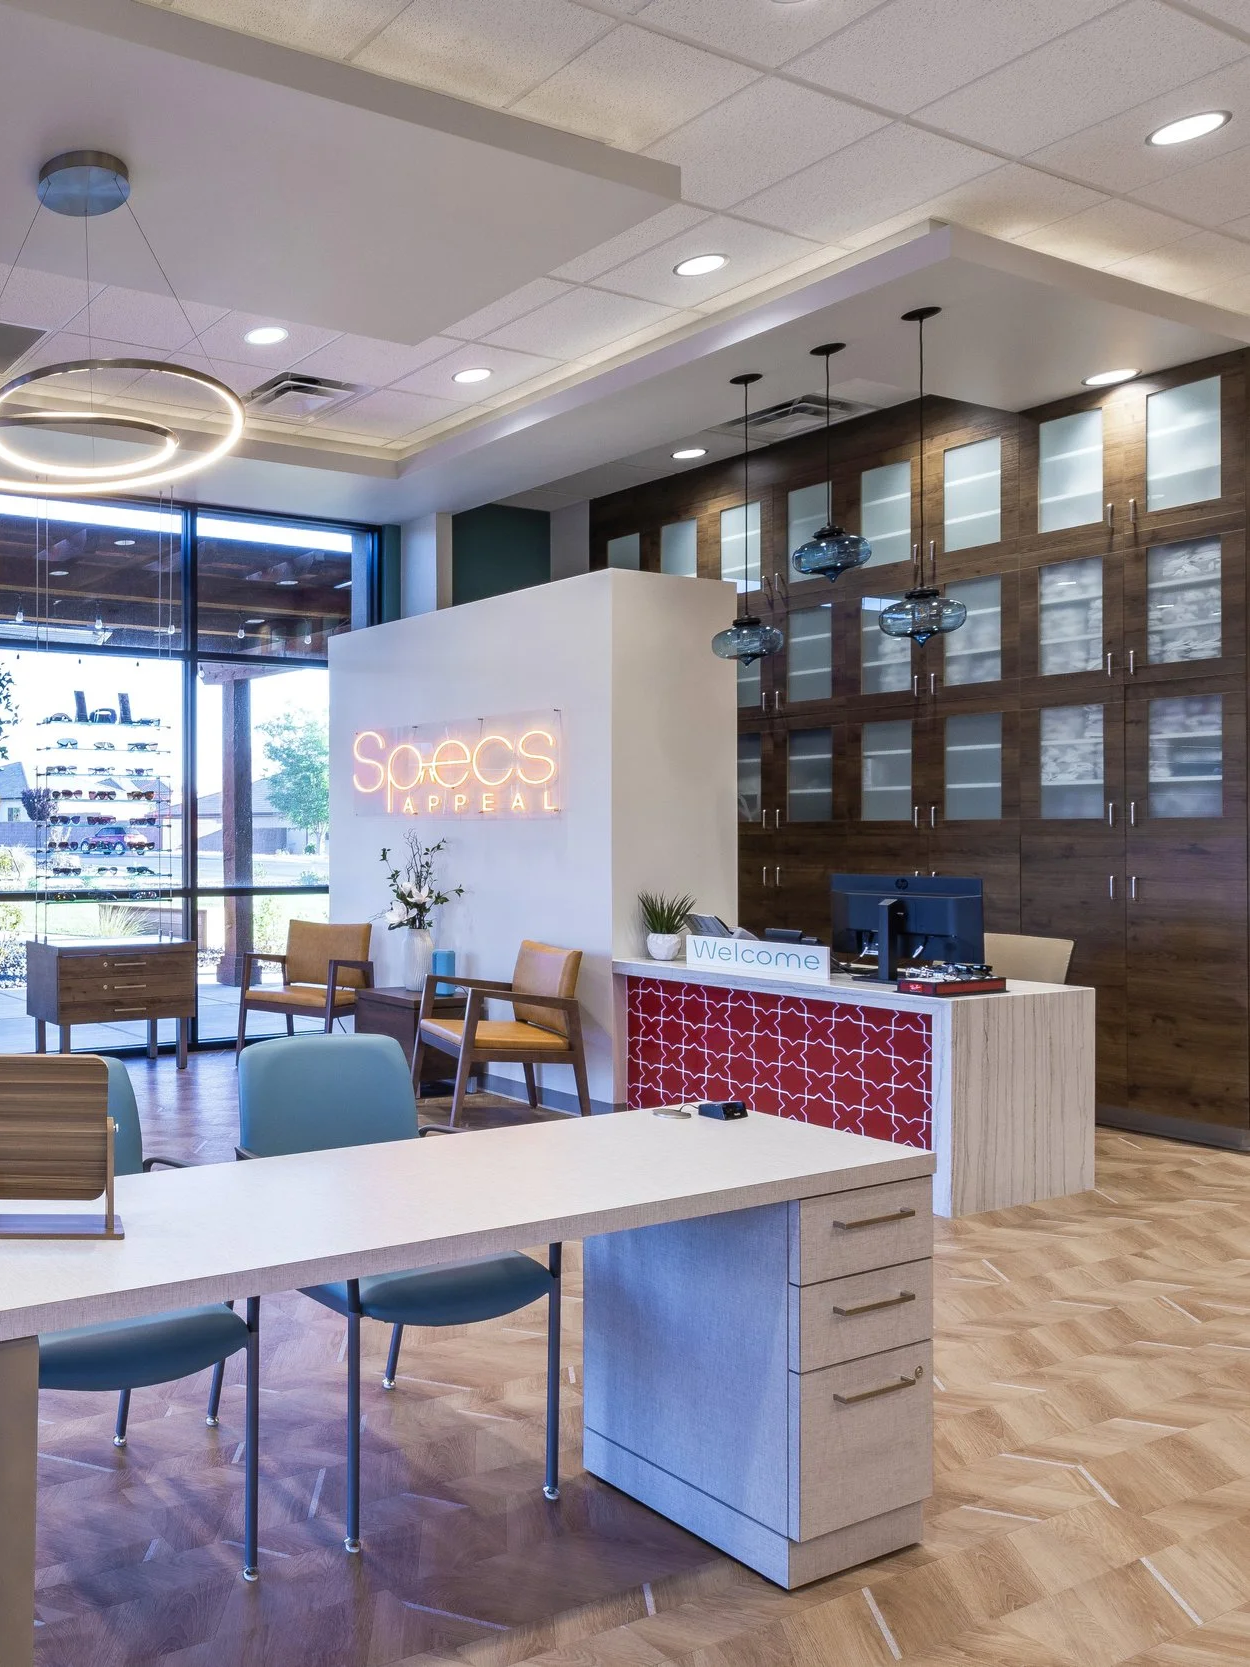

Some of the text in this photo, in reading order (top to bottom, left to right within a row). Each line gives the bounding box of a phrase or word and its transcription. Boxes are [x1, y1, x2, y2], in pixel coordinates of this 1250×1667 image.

[353, 730, 556, 813] Specs
[402, 791, 558, 814] APPEAL
[693, 939, 820, 970] Welcome
